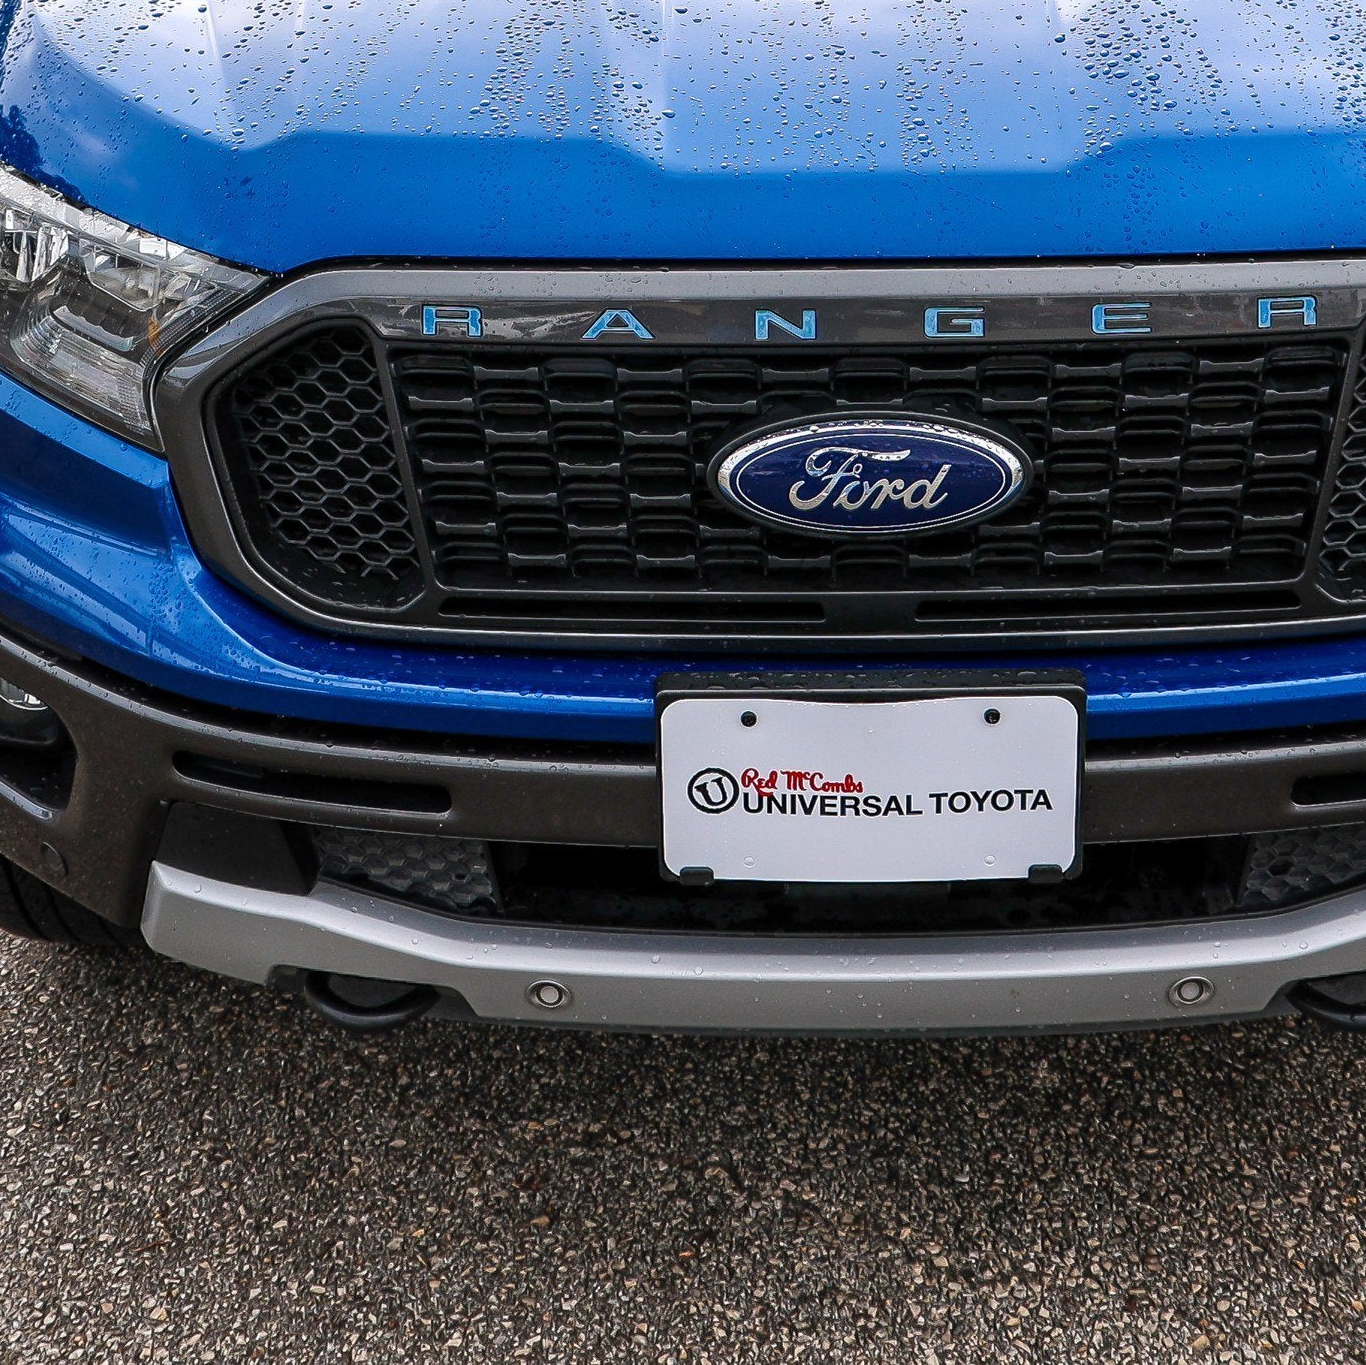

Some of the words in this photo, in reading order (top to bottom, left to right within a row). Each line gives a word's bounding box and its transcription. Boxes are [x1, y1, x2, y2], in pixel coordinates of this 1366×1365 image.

[421, 295, 1318, 341] RANGER
[788, 446, 952, 510] Ford
[741, 767, 779, 797] Red
[780, 769, 864, 793] McCombs
[742, 791, 924, 817] UNIVERSAL
[928, 788, 1054, 815] TOYOTA
